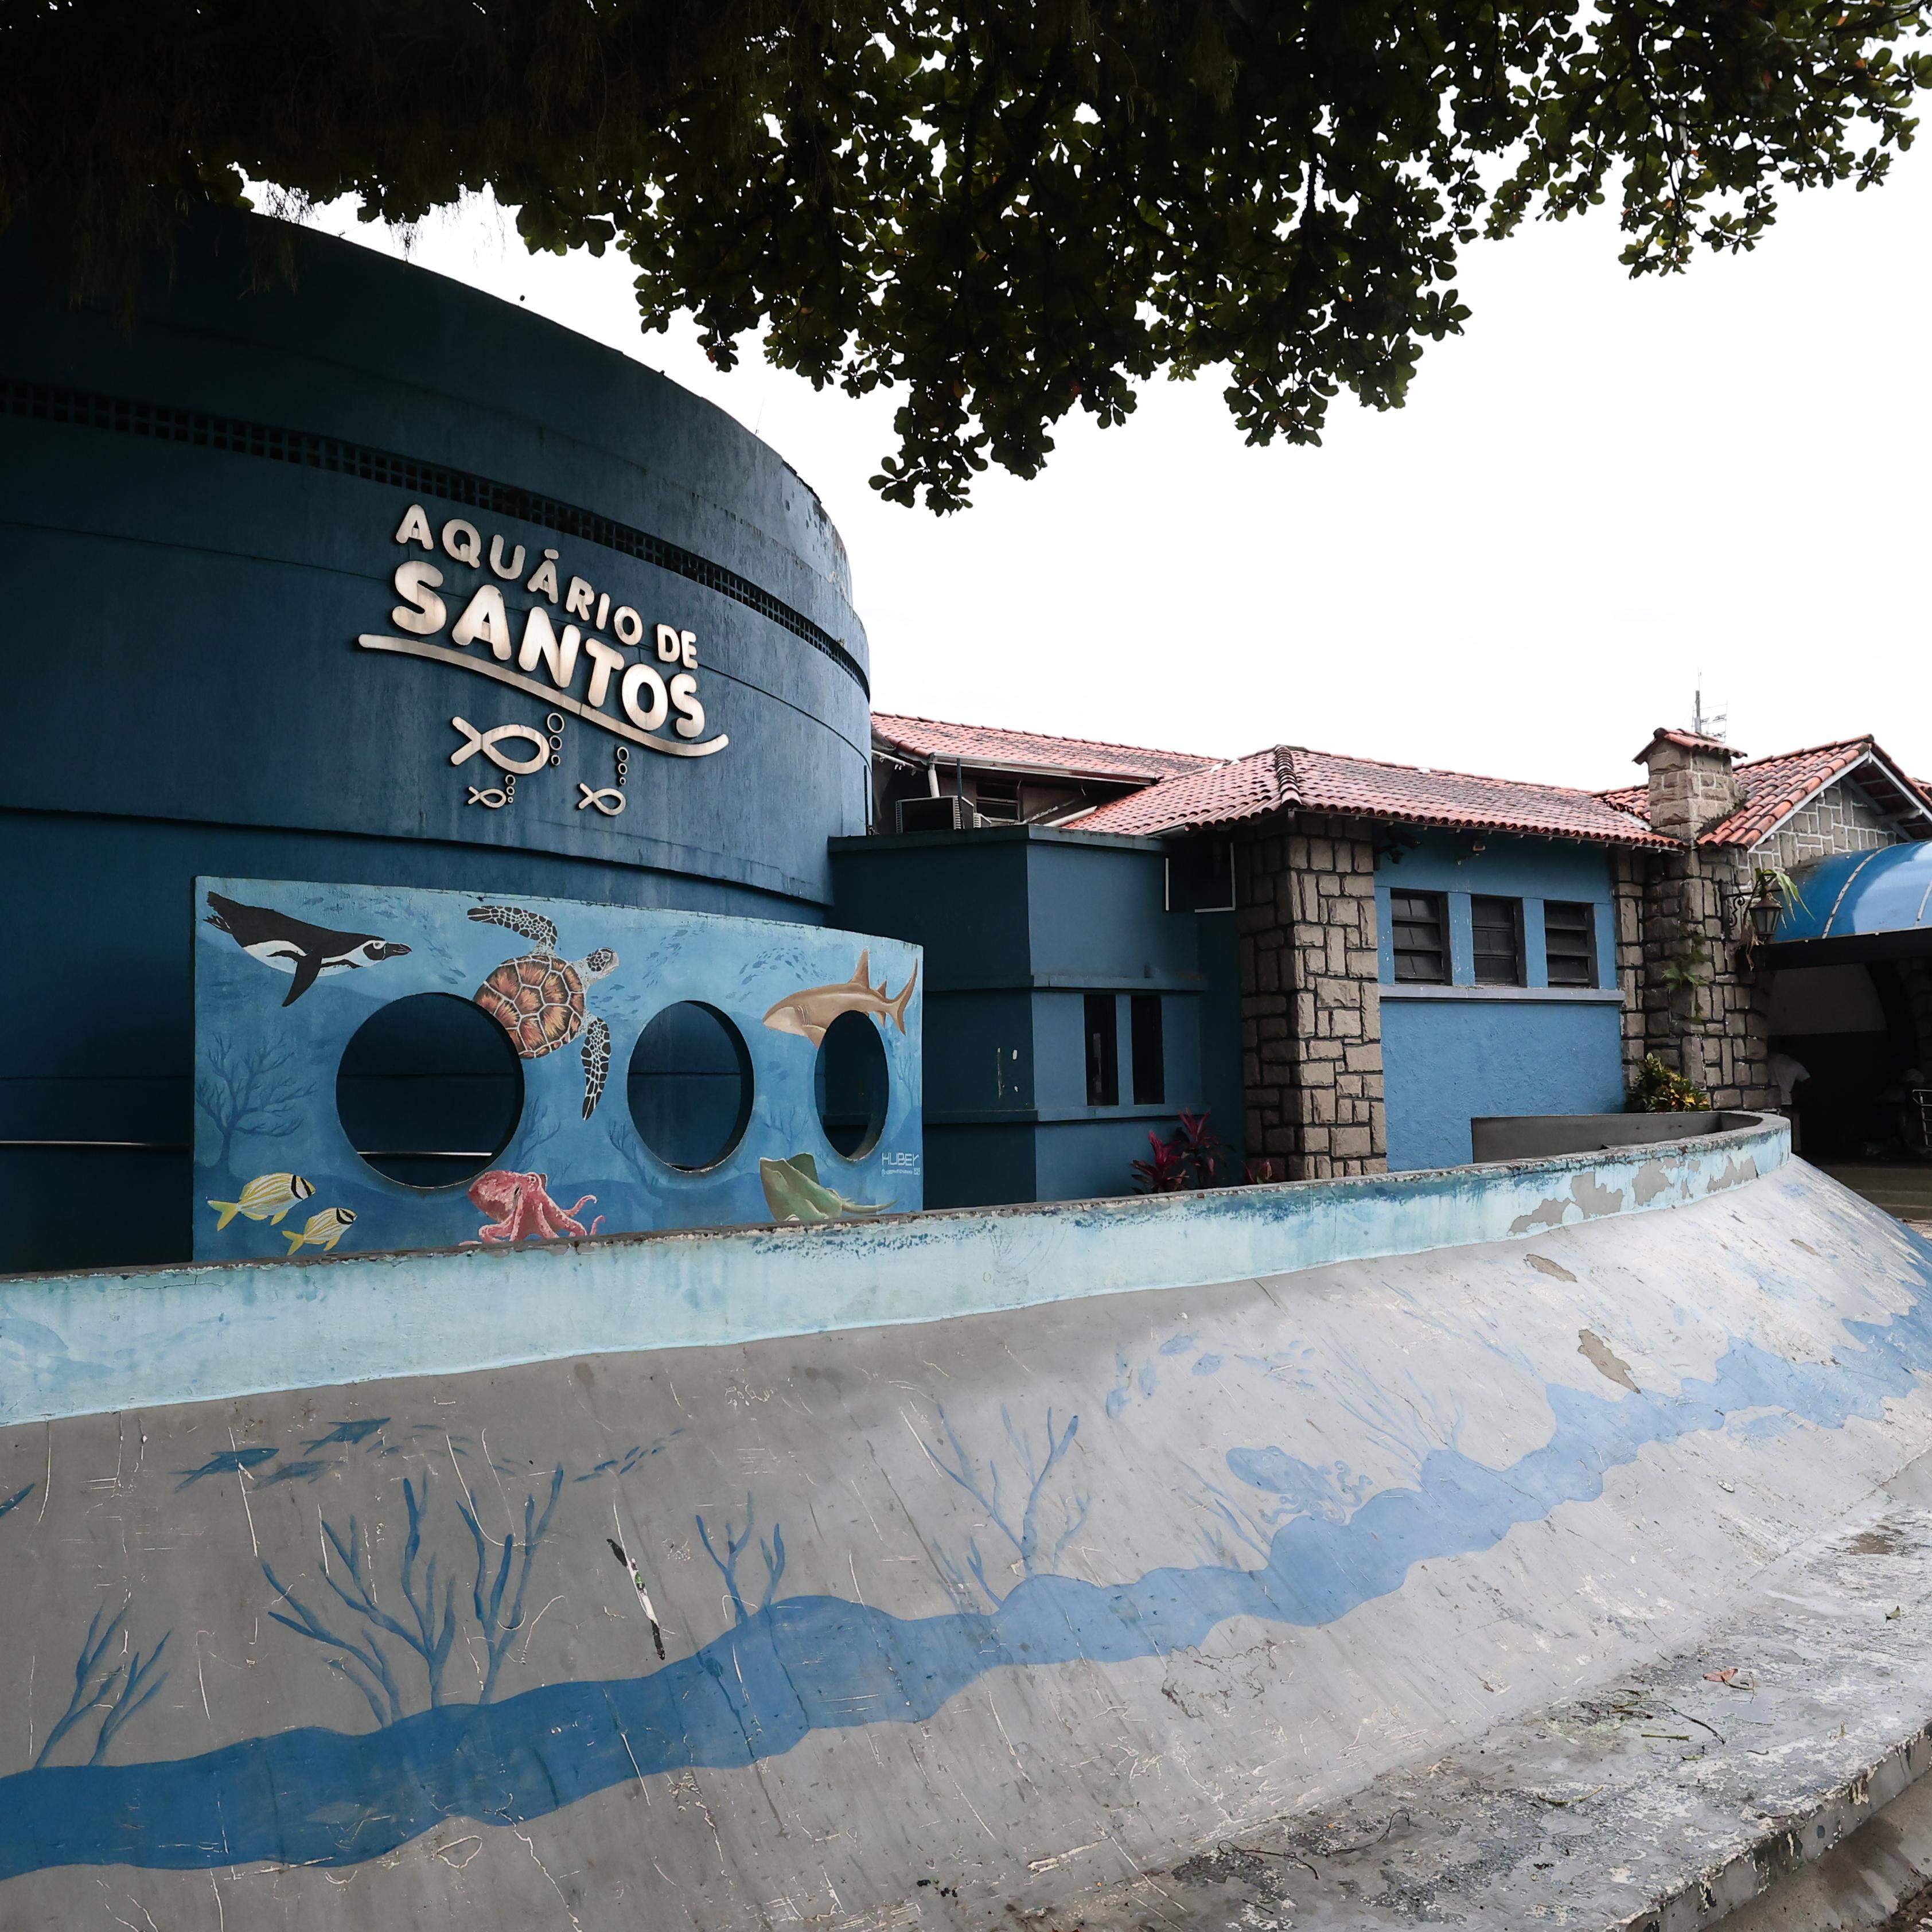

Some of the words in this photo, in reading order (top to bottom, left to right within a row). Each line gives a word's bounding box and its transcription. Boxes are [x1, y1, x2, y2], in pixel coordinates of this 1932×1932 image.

[392, 560, 705, 738] SANTOS
[396, 504, 643, 645] AQUÁRIO
[657, 624, 698, 669] DE
[882, 1152, 919, 1166] HUBEY
